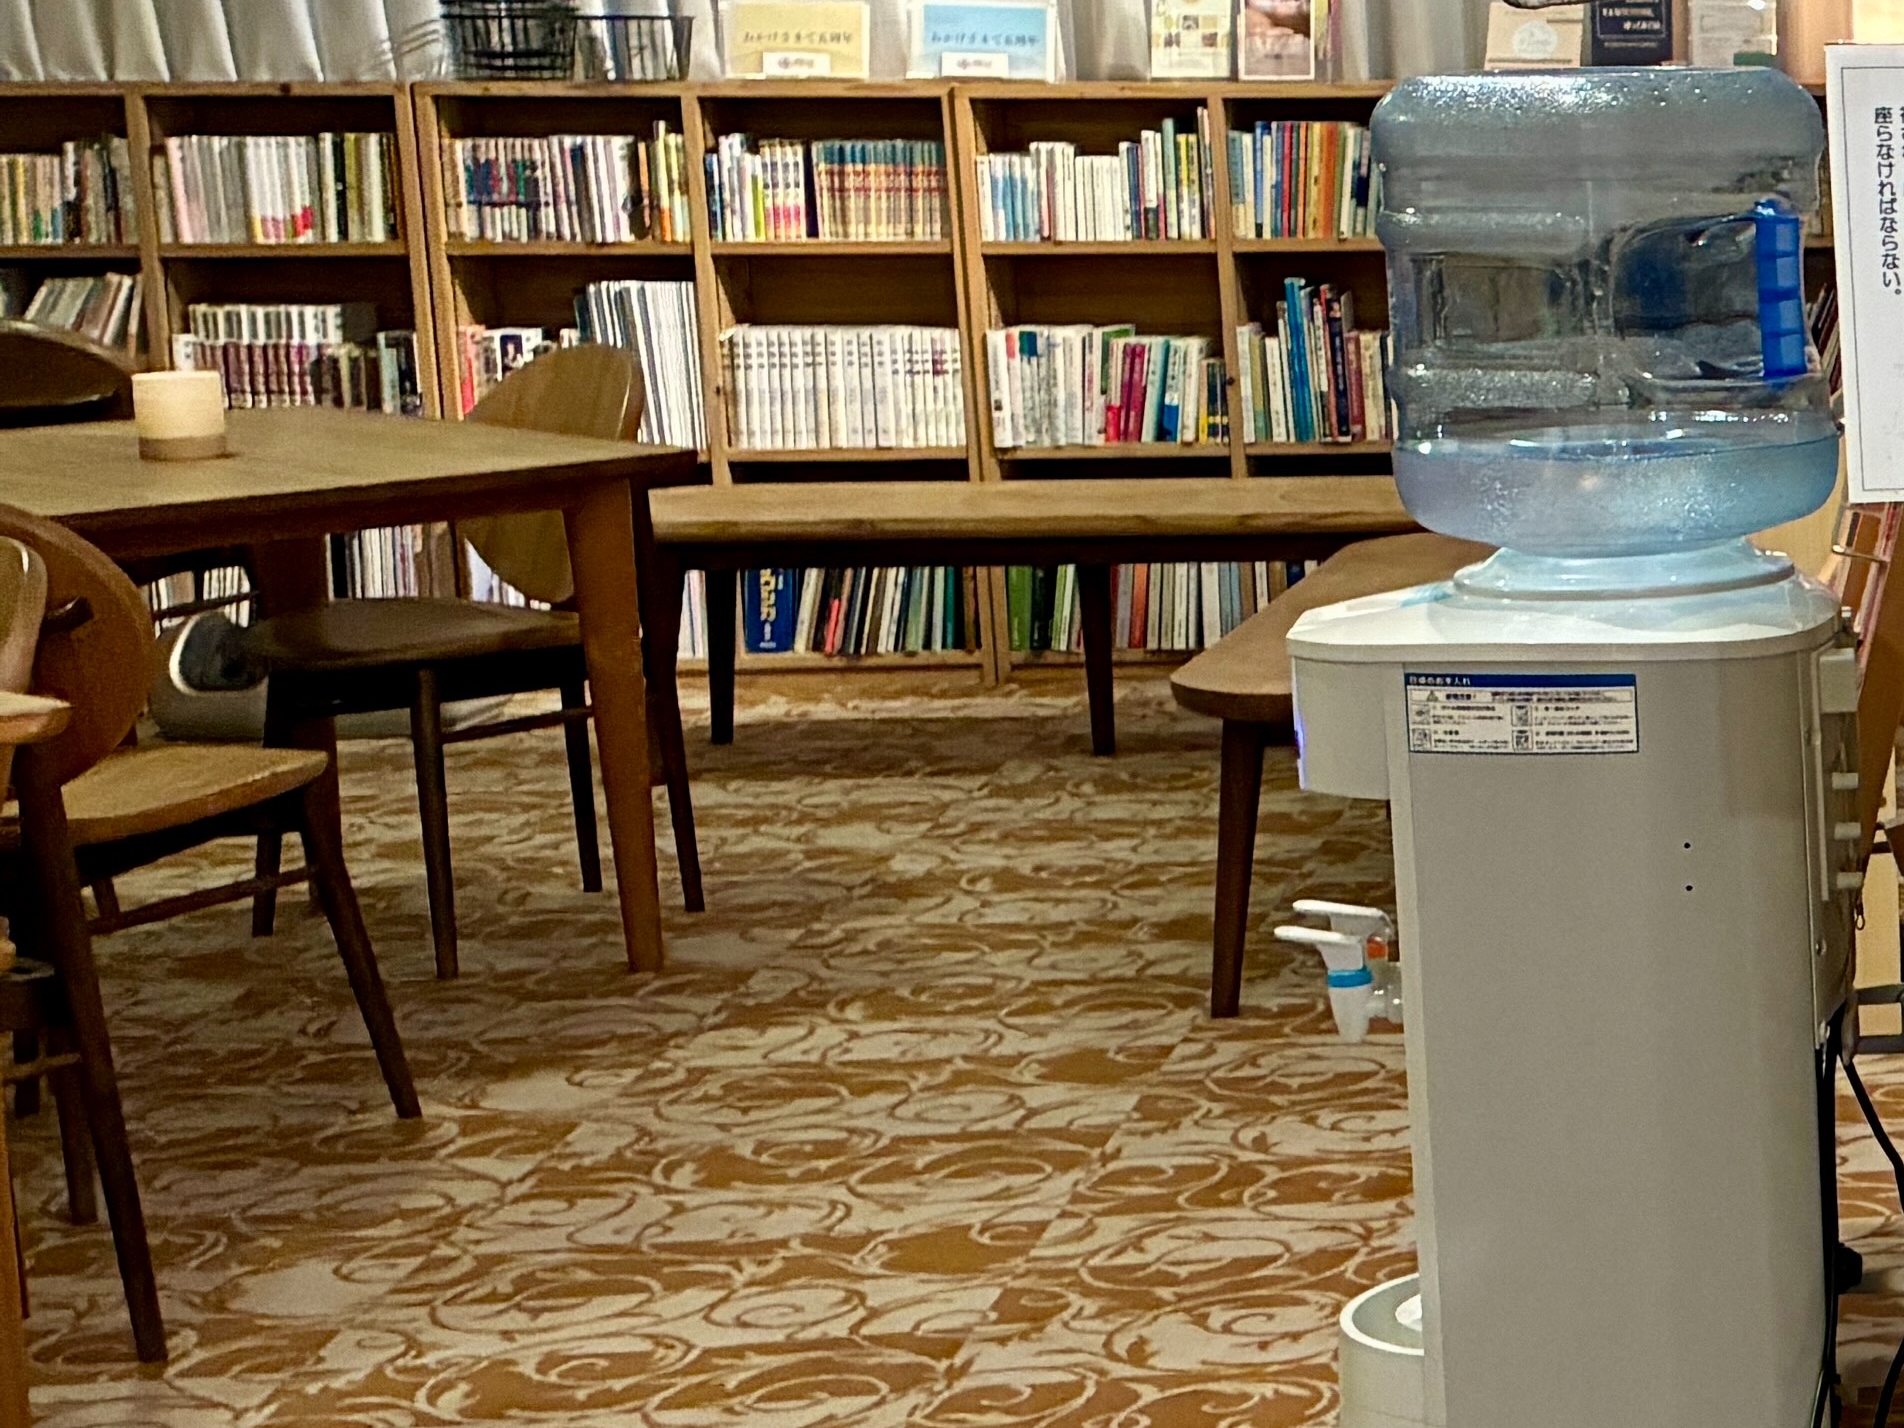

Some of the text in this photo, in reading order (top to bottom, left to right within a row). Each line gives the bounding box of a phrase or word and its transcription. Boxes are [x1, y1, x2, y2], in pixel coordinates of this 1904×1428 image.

[1874, 106, 1902, 295] 座らなければならない。
